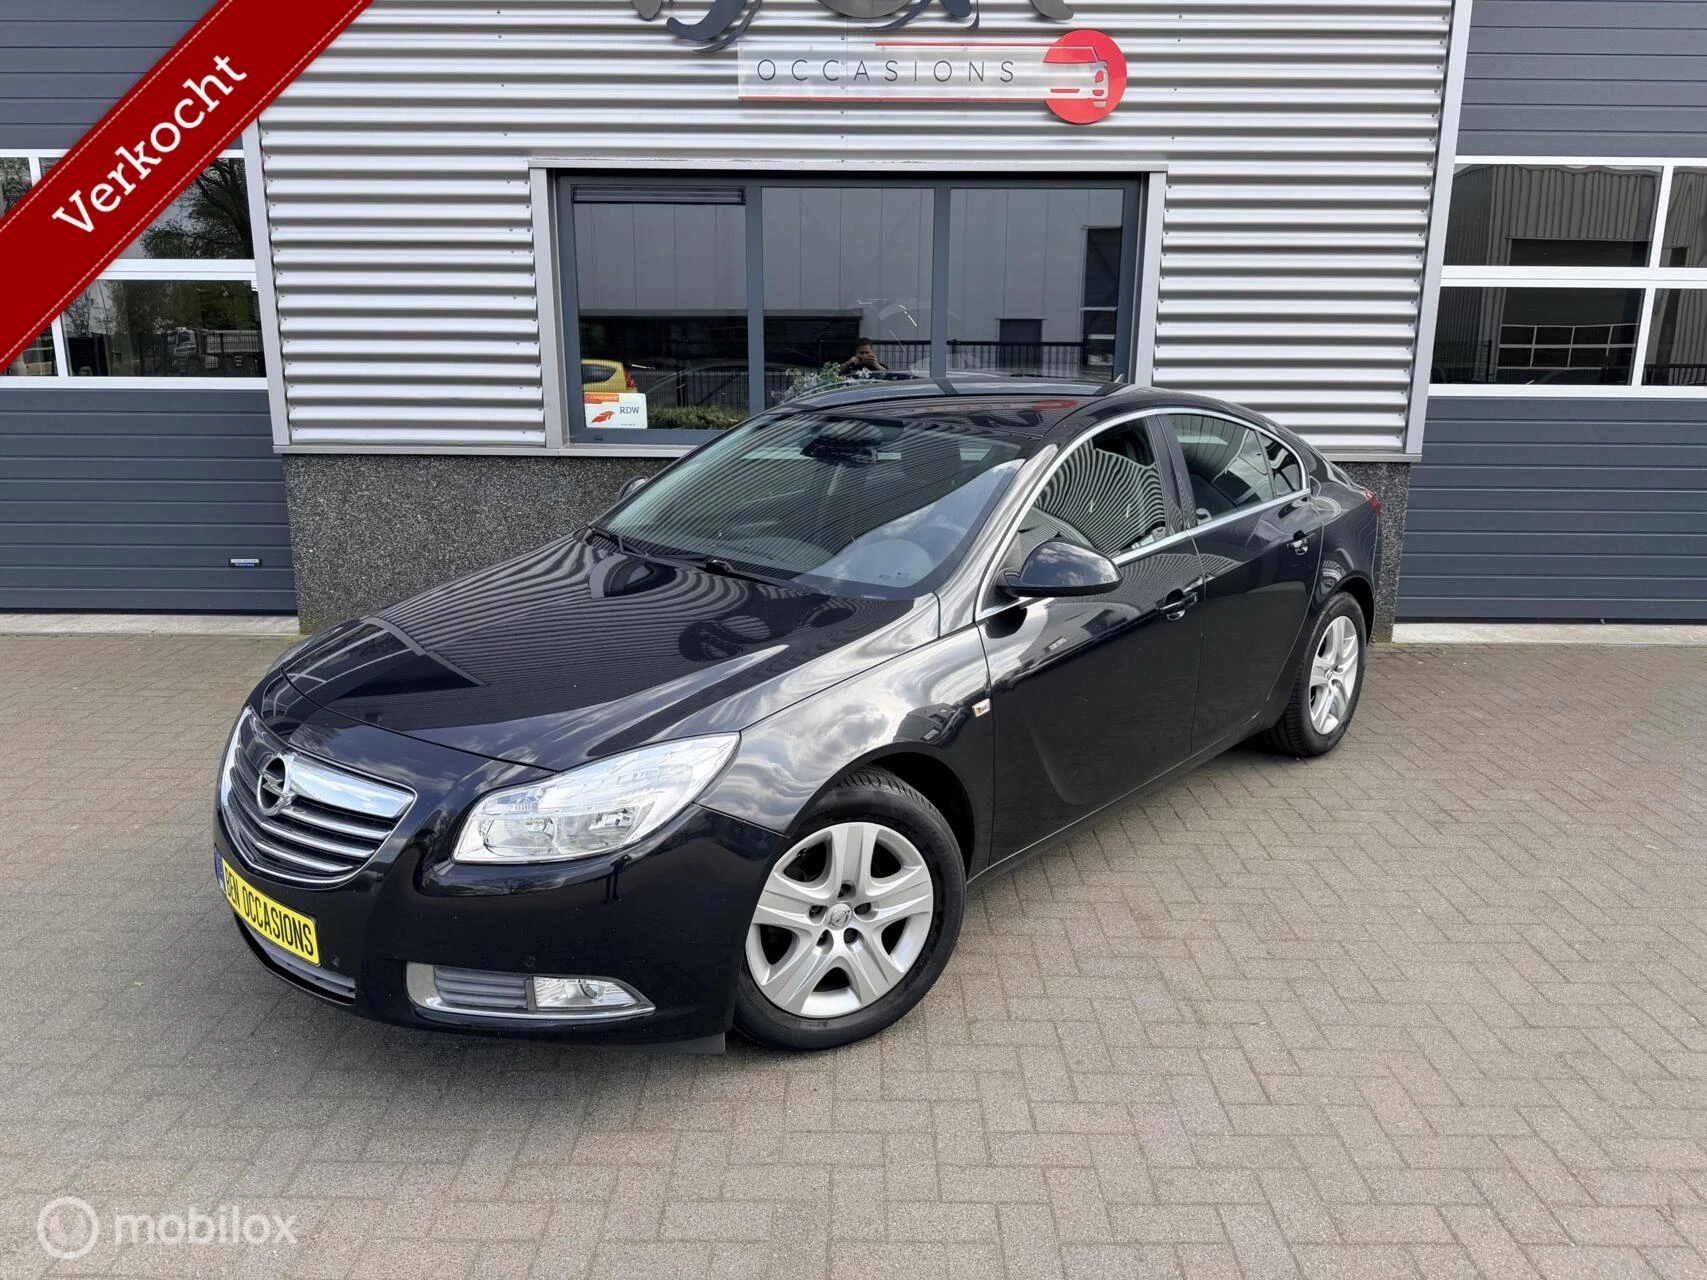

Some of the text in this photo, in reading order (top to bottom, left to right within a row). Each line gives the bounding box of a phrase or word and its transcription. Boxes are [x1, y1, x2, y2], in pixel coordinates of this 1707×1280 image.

[756, 58, 1016, 84] OCCASIONS
[619, 406, 640, 415] RDW
[242, 885, 314, 957] OCCASIONS
